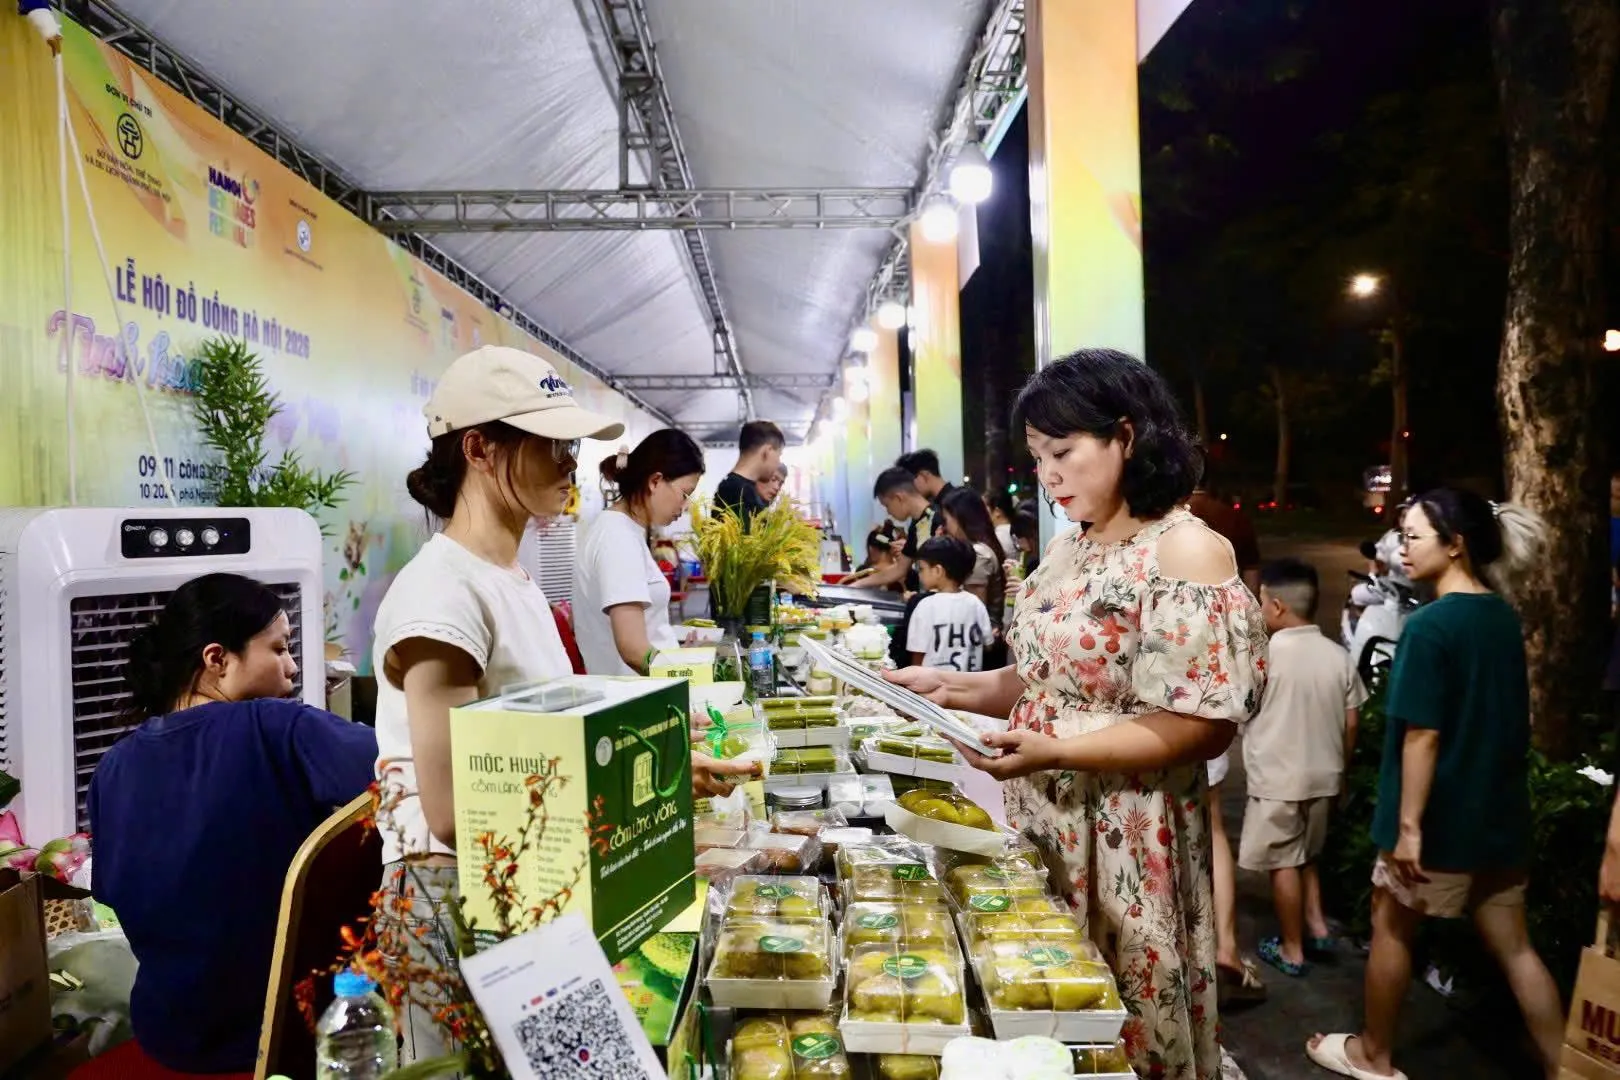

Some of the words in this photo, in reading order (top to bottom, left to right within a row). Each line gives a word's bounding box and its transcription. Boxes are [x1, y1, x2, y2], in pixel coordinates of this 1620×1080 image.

[208, 165, 242, 199] HANOI
[116, 258, 137, 304] LỄ
[142, 273, 170, 319] HỘI
[176, 281, 197, 323] ĐỒ
[202, 290, 239, 336] UỐNG
[243, 310, 259, 343] HÀ
[263, 317, 282, 355] NỘI
[139, 455, 157, 477] 09
[164, 456, 174, 478] 11
[179, 458, 206, 479] CÔNG
[469, 753, 504, 775] MỘC
